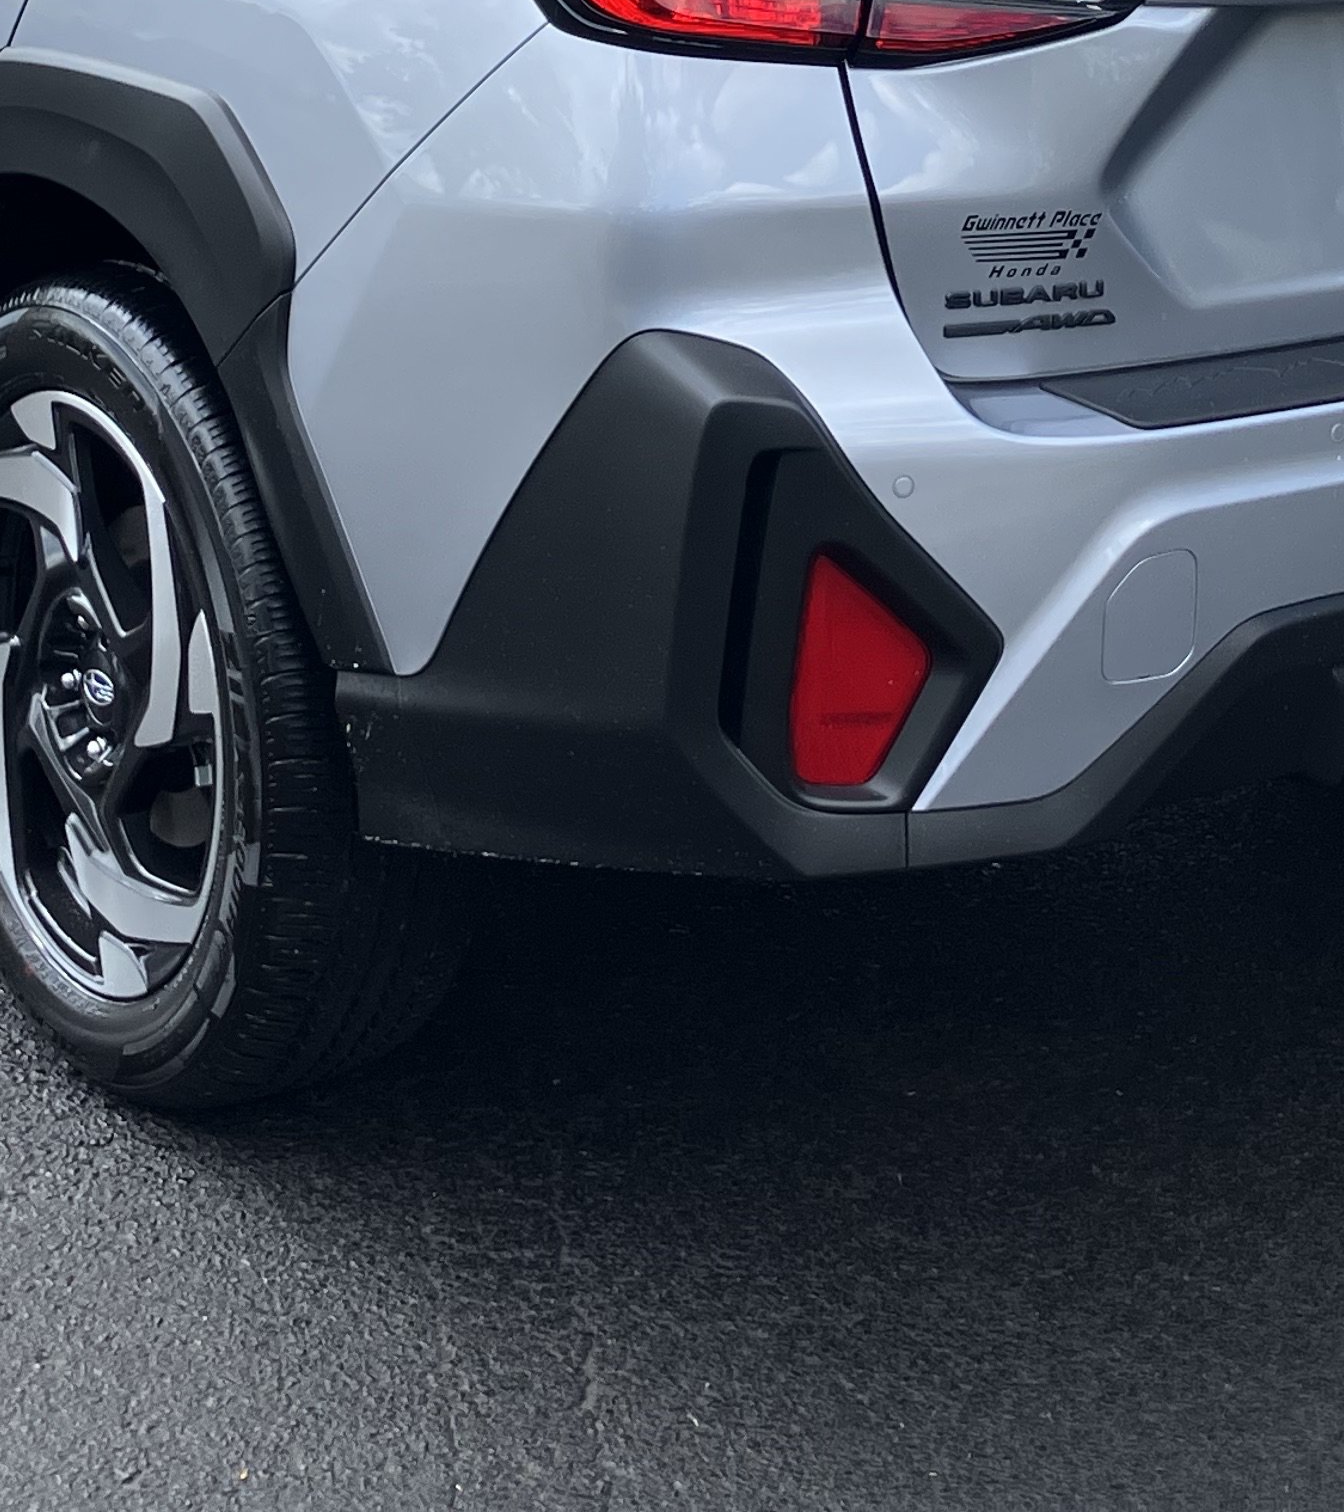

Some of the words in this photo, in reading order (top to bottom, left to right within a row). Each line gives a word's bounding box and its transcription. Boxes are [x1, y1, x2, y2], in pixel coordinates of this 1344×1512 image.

[961, 211, 1046, 232] Gwinnett
[1049, 210, 1102, 228] Place
[988, 263, 1062, 278] Honda
[944, 279, 1105, 310] SUBARU
[1005, 309, 1116, 334] AWD
